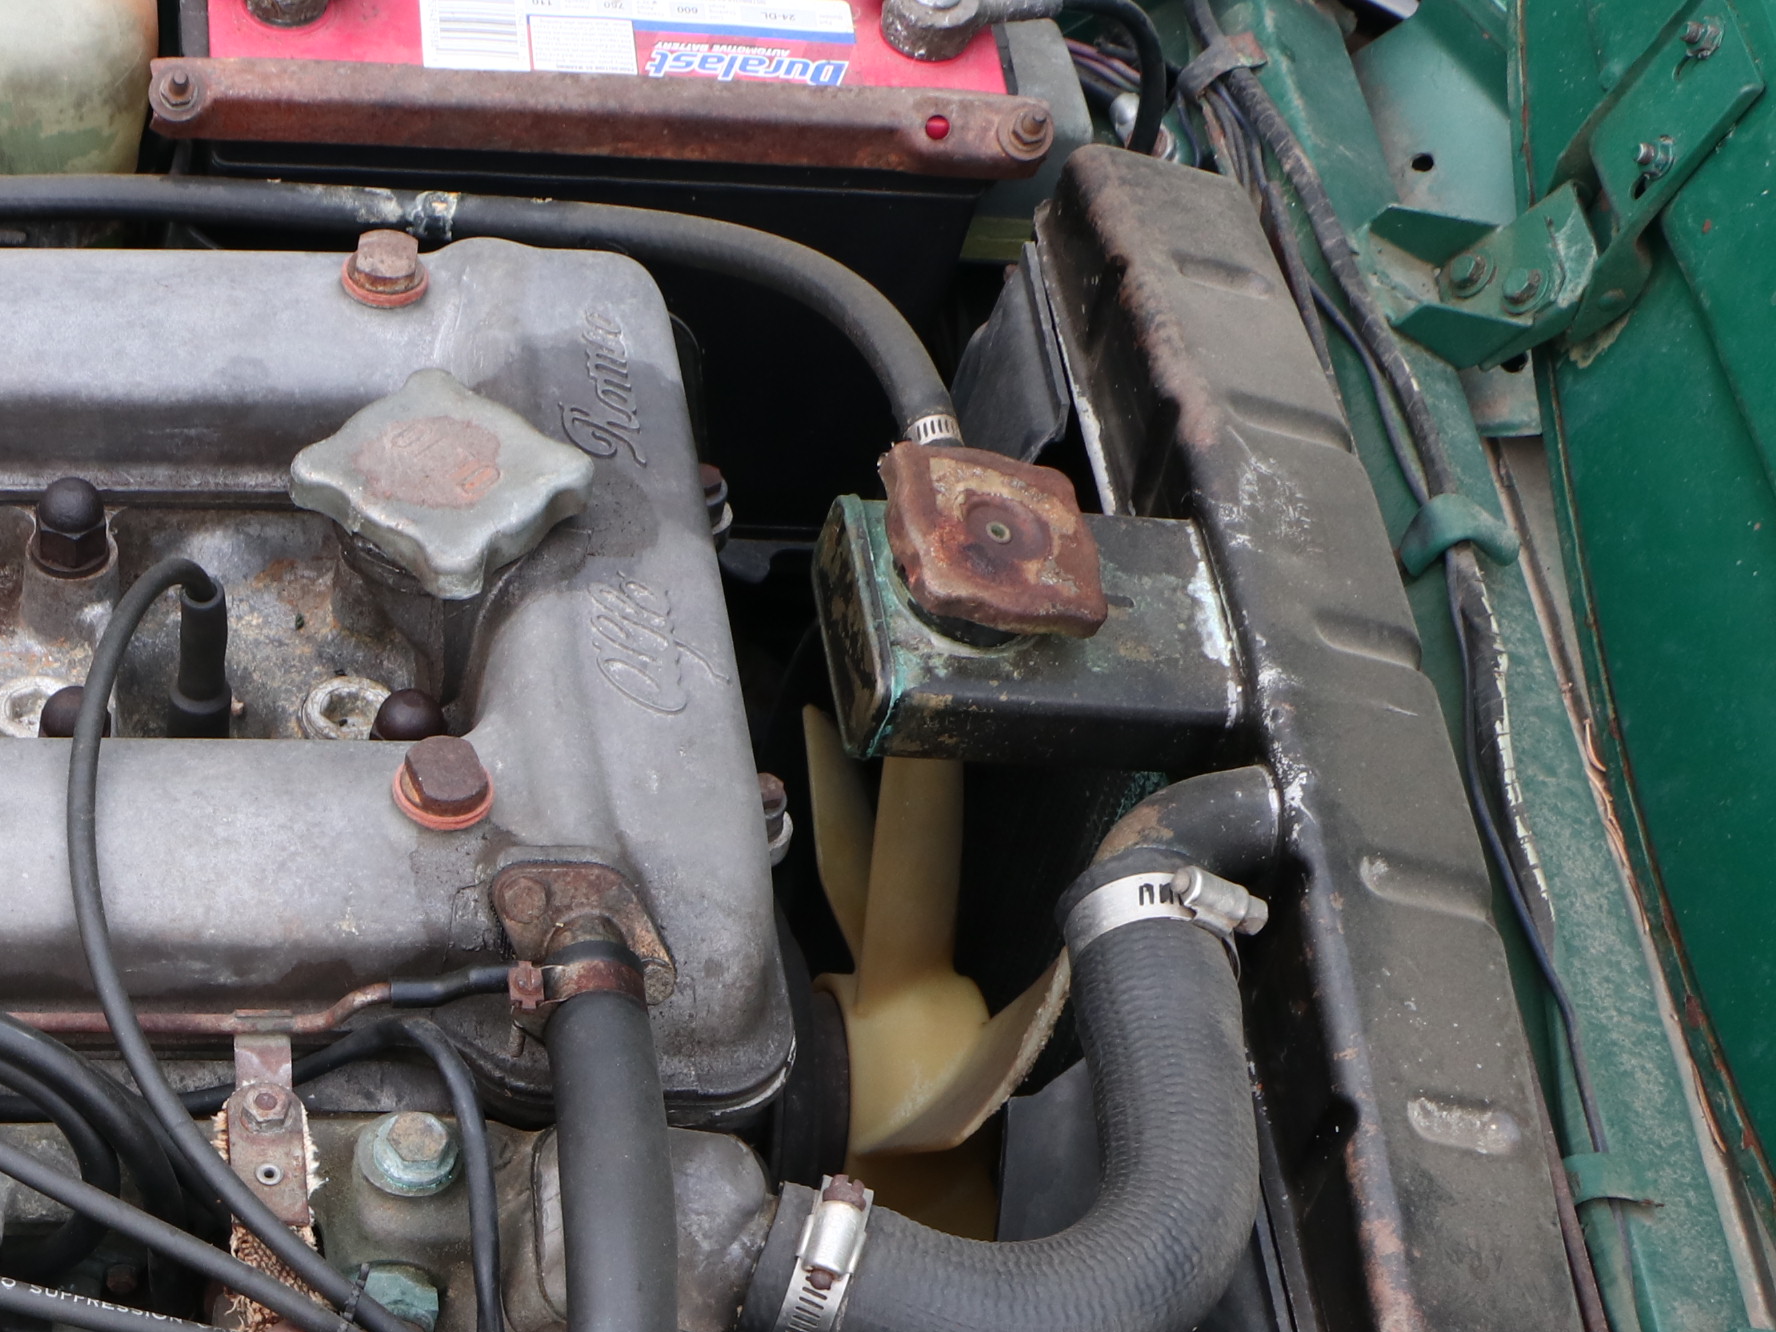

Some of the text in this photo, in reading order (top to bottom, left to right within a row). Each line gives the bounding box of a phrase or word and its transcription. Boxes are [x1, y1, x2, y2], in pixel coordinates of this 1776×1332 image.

[654, 40, 792, 58] AUTOMOTIVE BATTERY
[645, 49, 849, 87] Duralast
